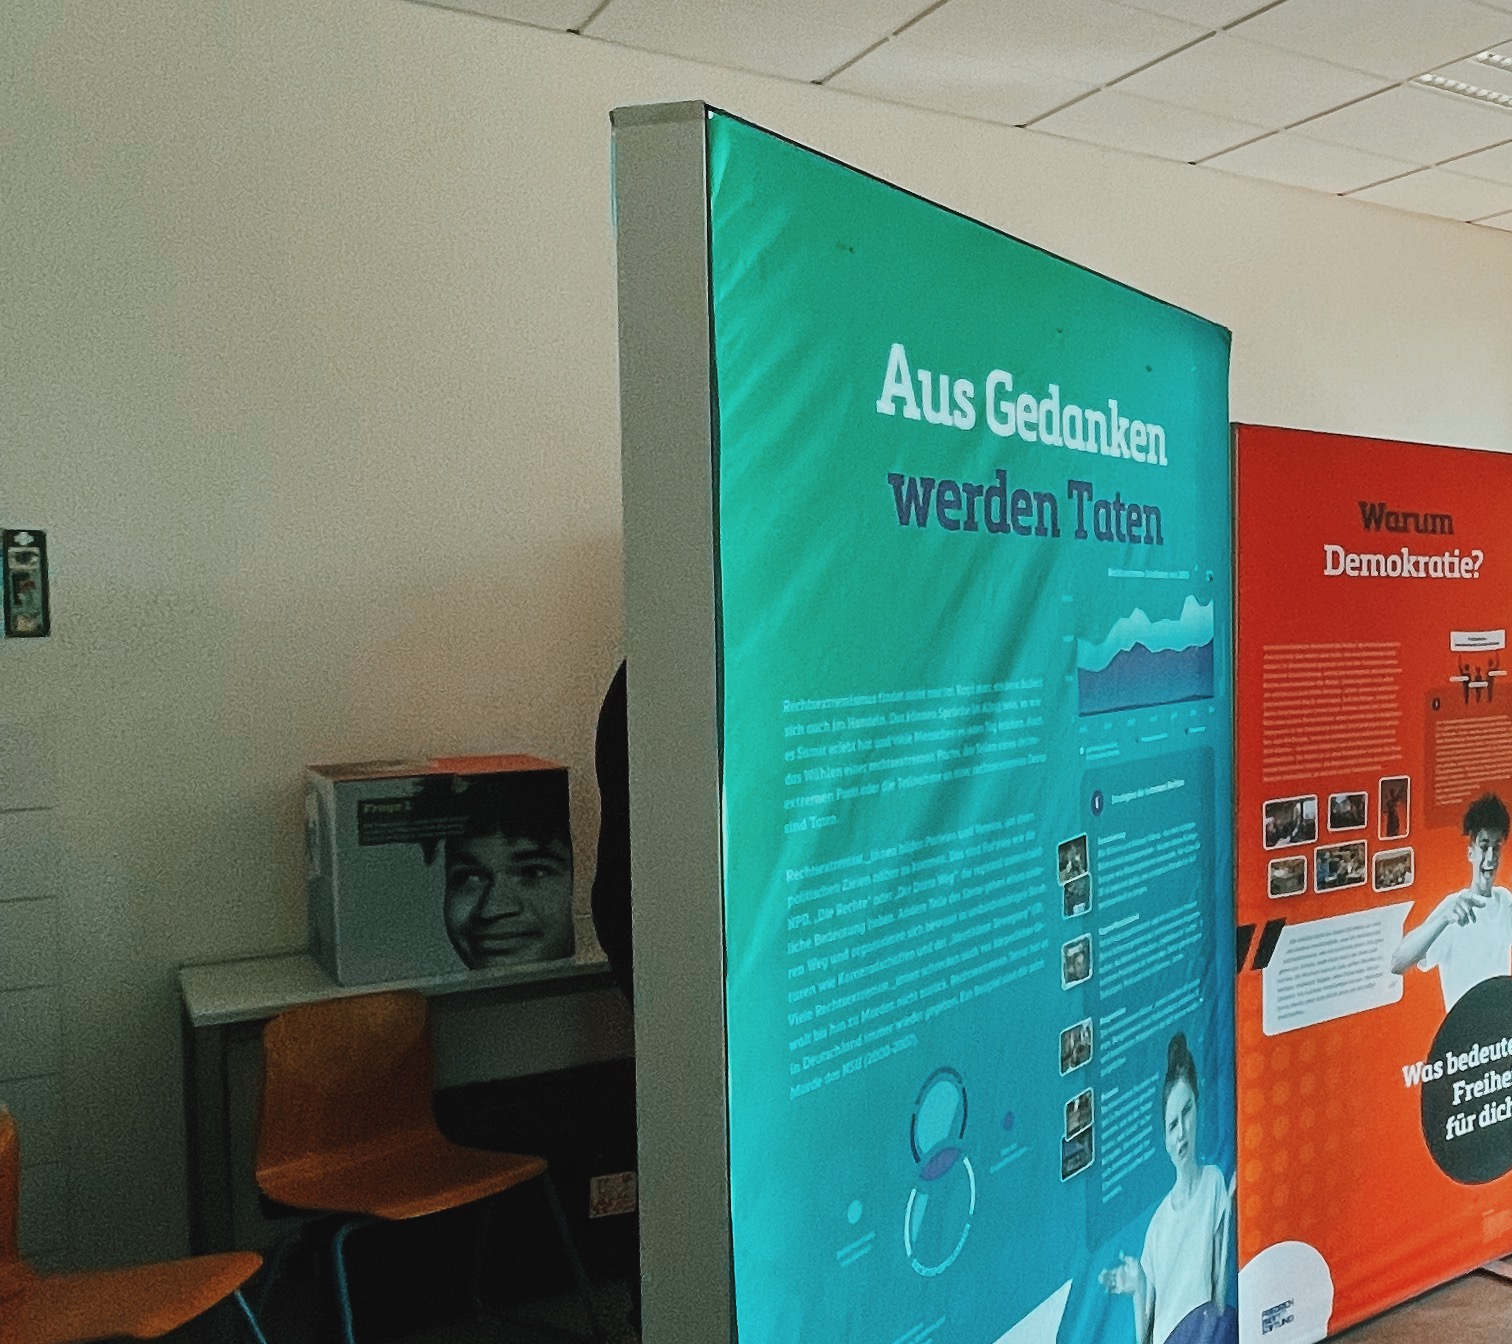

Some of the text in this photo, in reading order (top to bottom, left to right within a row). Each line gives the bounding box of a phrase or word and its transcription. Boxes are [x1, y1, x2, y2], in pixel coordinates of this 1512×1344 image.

[876, 342, 1169, 466] Aus Gedanken
[887, 467, 1165, 545] werden Taten
[1358, 501, 1455, 536] Warum
[1323, 544, 1484, 579] Demokratie?
[1402, 1060, 1443, 1087] Was
[1445, 1116, 1476, 1141] für
